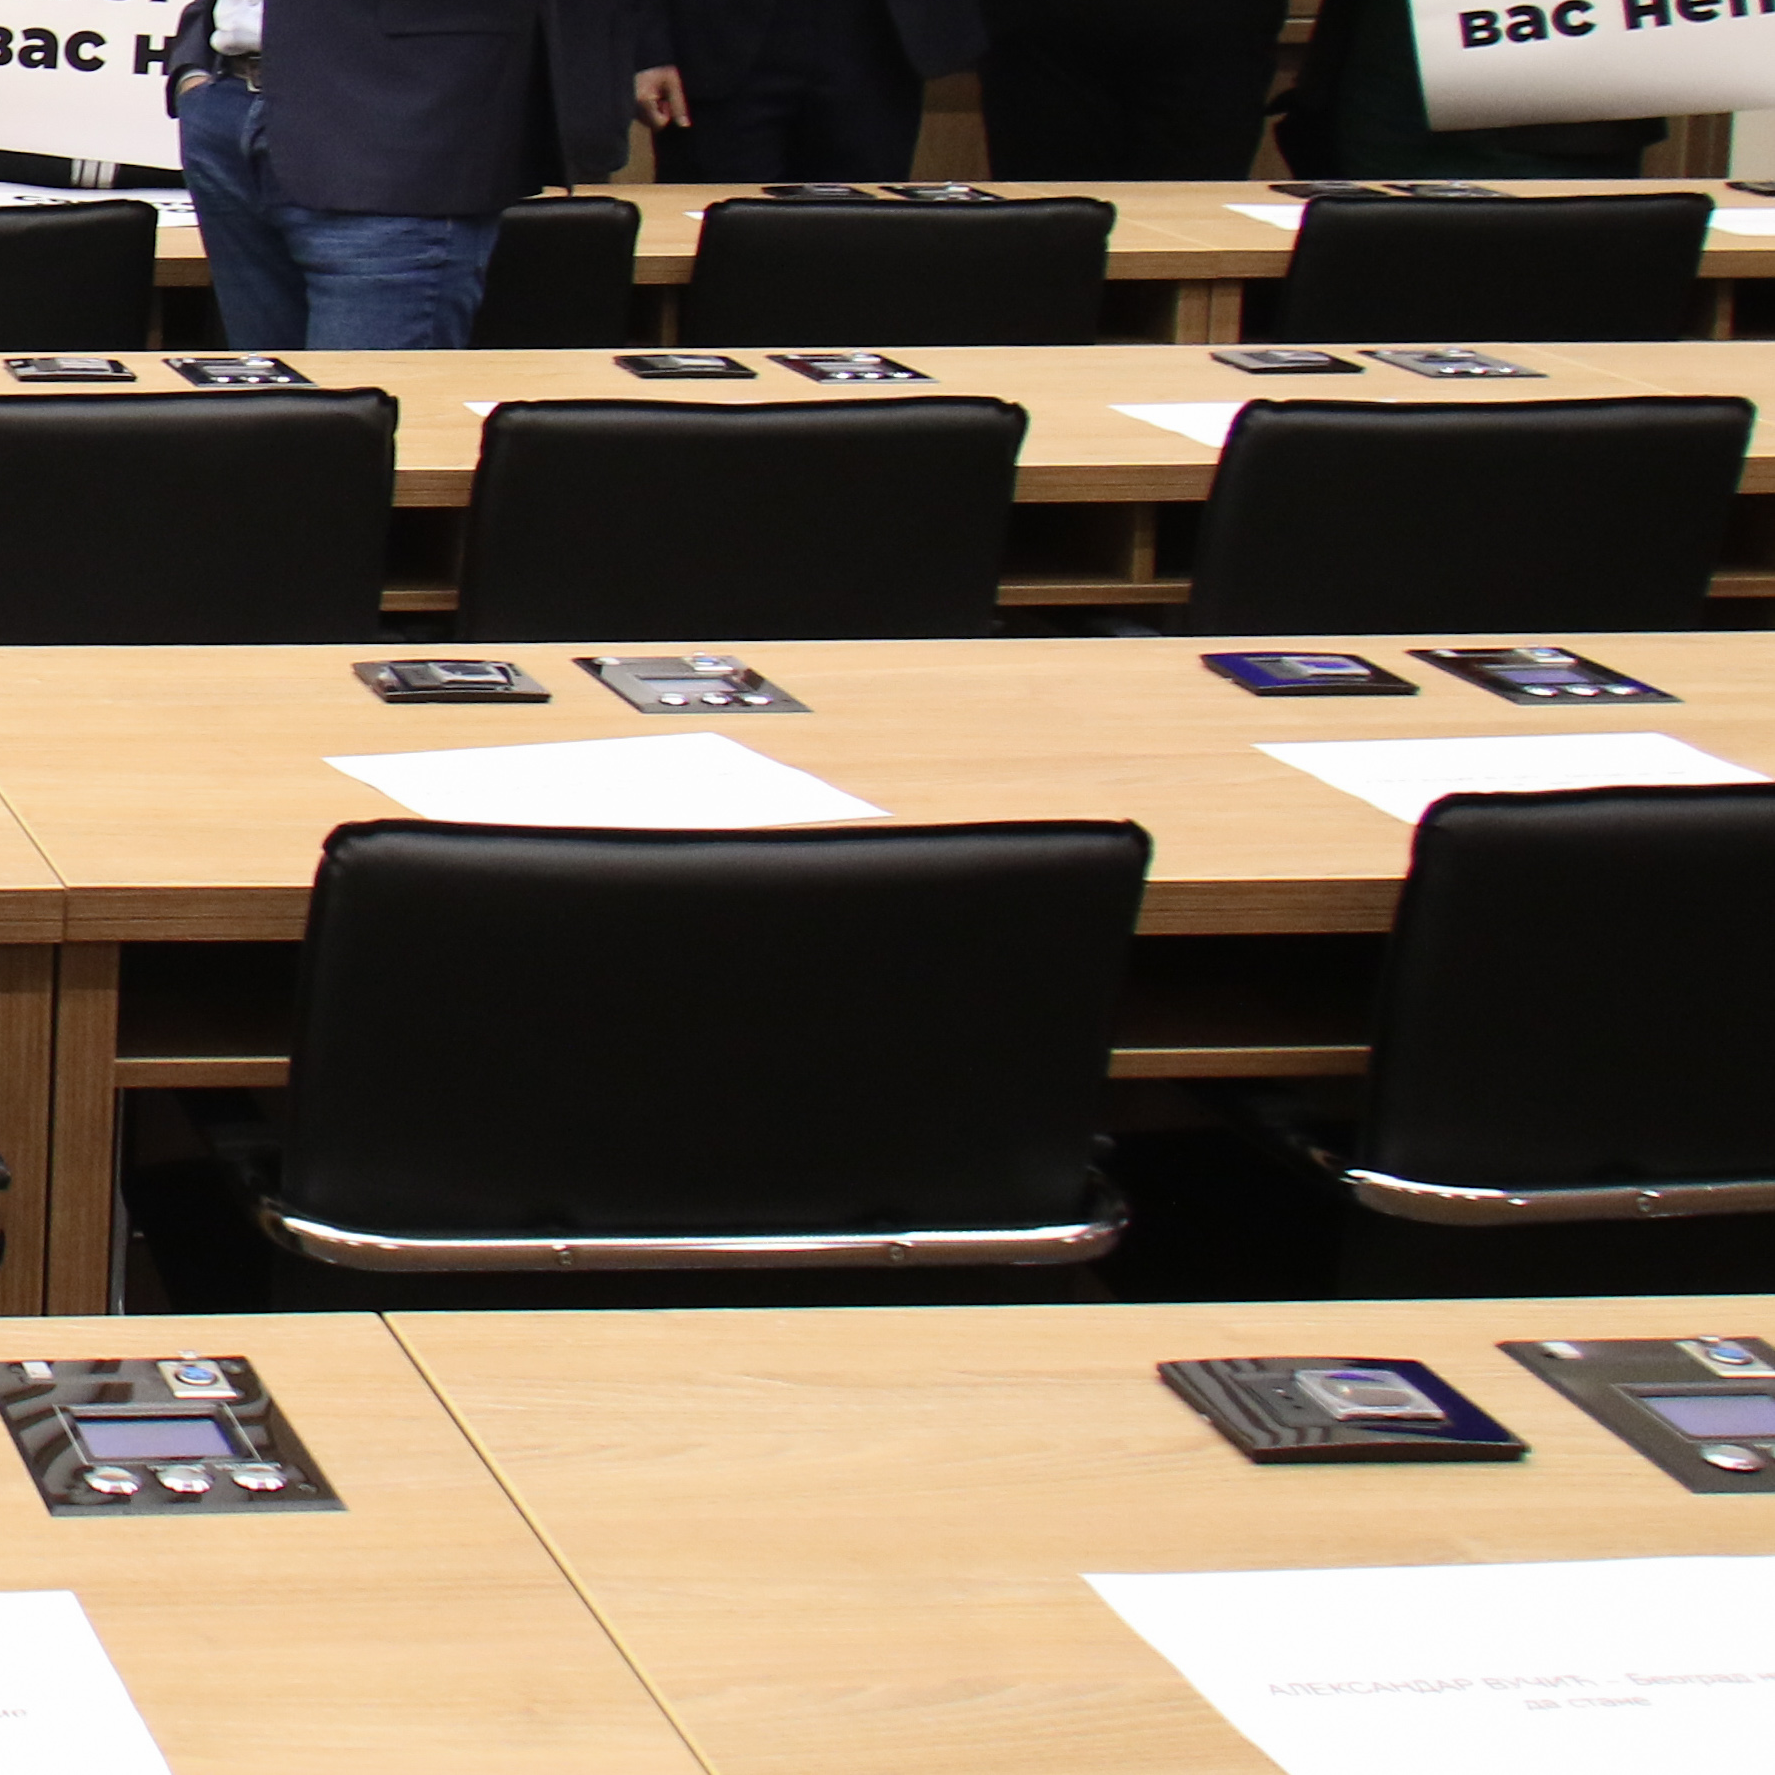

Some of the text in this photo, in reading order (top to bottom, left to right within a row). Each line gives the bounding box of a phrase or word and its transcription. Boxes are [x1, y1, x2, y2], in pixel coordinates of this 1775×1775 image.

[1459, 0, 1595, 48] вас
[1267, 1678, 1474, 1697] АЛЕКСАНДАР
[1482, 1675, 1597, 1690] ВУЧИЋ
